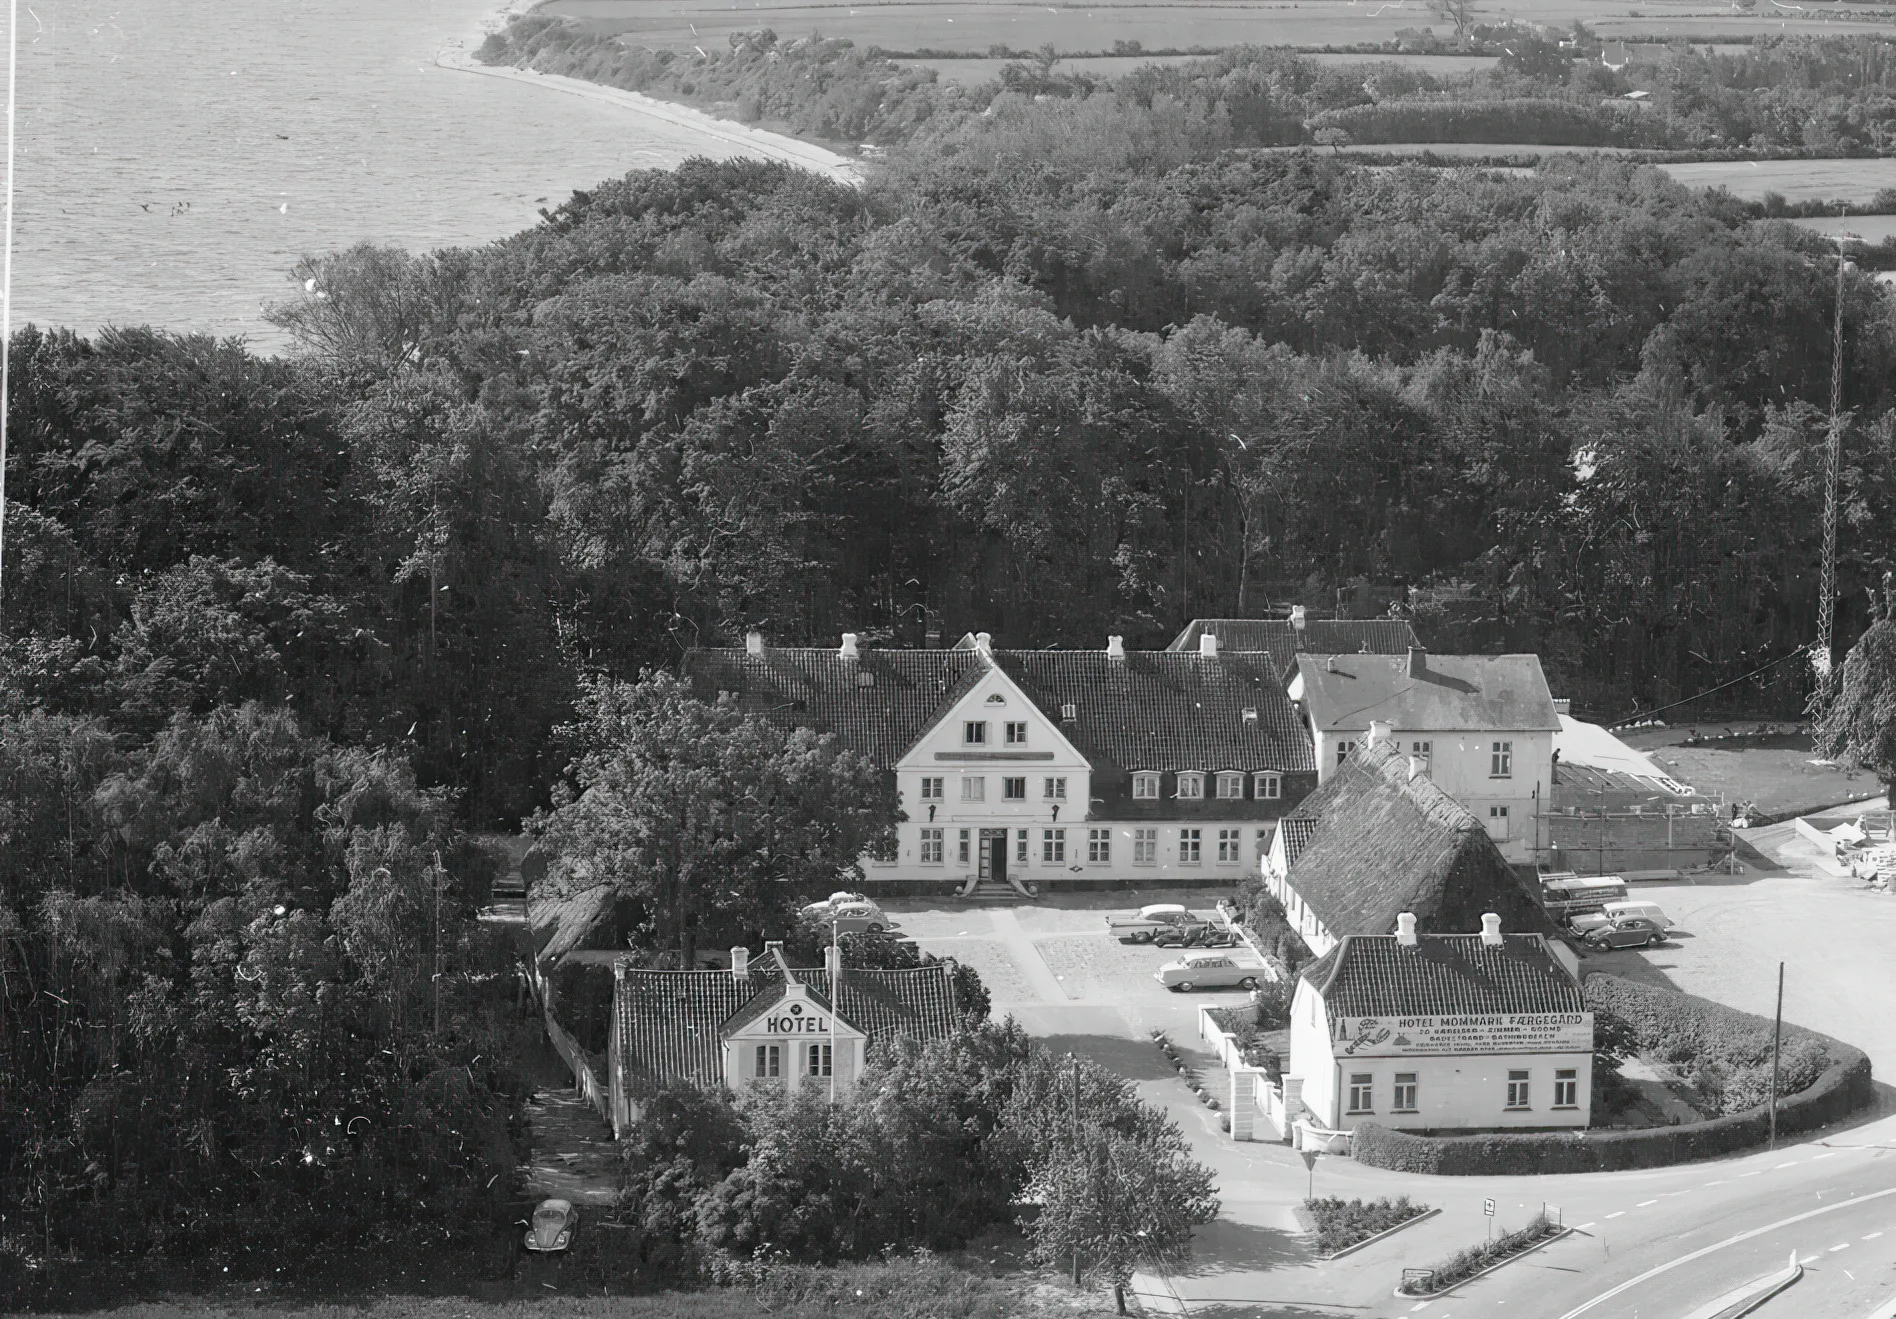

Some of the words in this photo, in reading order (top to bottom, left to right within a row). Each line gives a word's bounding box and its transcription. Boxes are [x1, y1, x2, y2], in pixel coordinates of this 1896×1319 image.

[768, 1017, 828, 1033] HOTEL
[1399, 1018, 1435, 1028] HOTEL
[1440, 1017, 1503, 1026] MOMMARK
